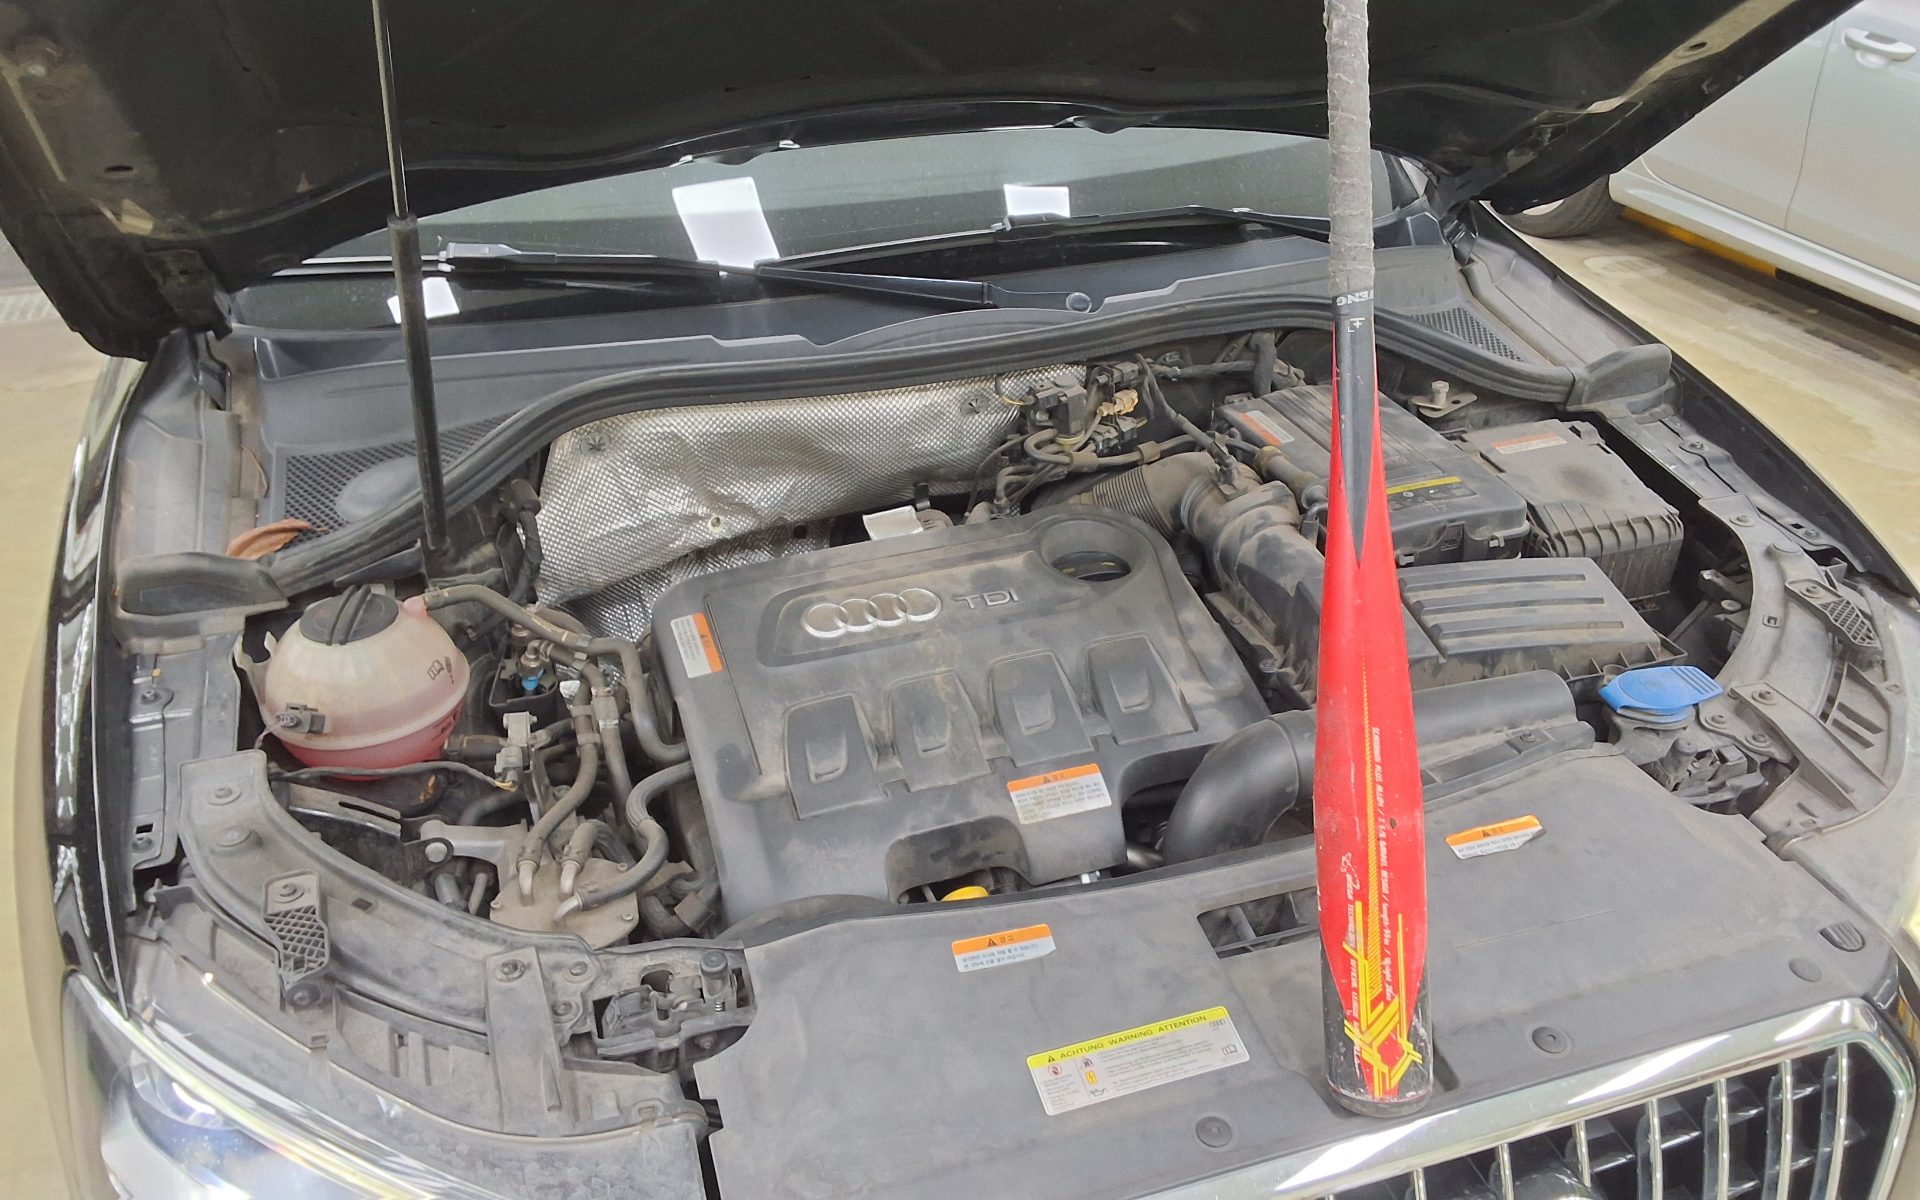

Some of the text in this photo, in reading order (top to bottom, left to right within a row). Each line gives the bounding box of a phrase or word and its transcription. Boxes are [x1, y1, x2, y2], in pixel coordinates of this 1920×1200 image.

[952, 588, 1019, 608] TDI
[1060, 1015, 1207, 1058] ACHTUNG WARNING ATTENTION
